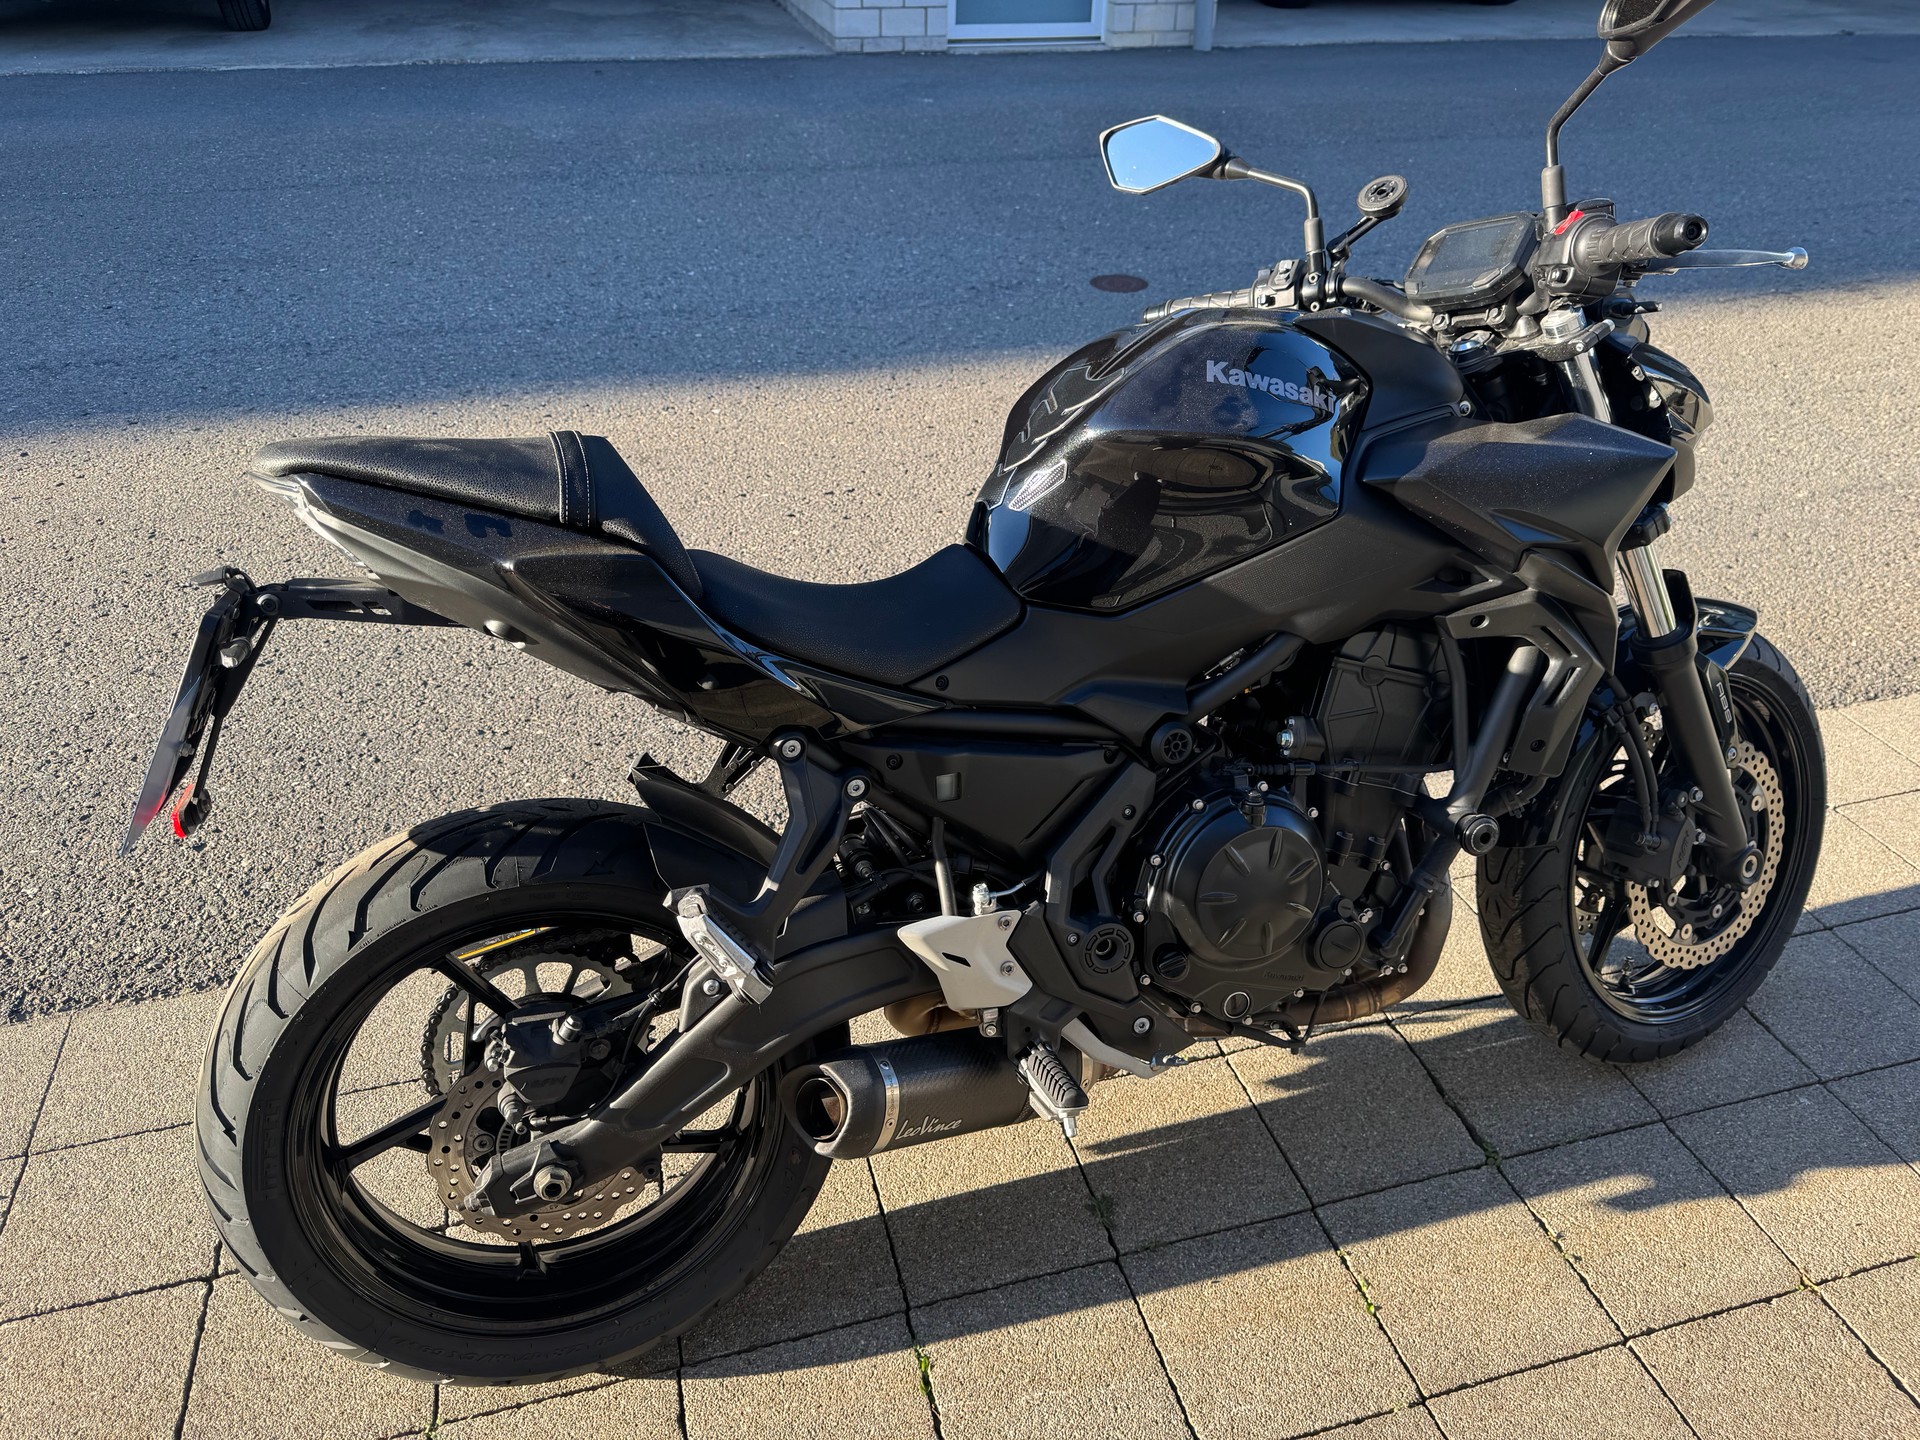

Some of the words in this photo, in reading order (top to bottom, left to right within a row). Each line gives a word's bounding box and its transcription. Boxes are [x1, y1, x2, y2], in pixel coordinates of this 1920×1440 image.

[1206, 360, 1337, 413] Kawasaki
[1715, 682, 1733, 723] ABS
[895, 1116, 962, 1140] LeoVince
